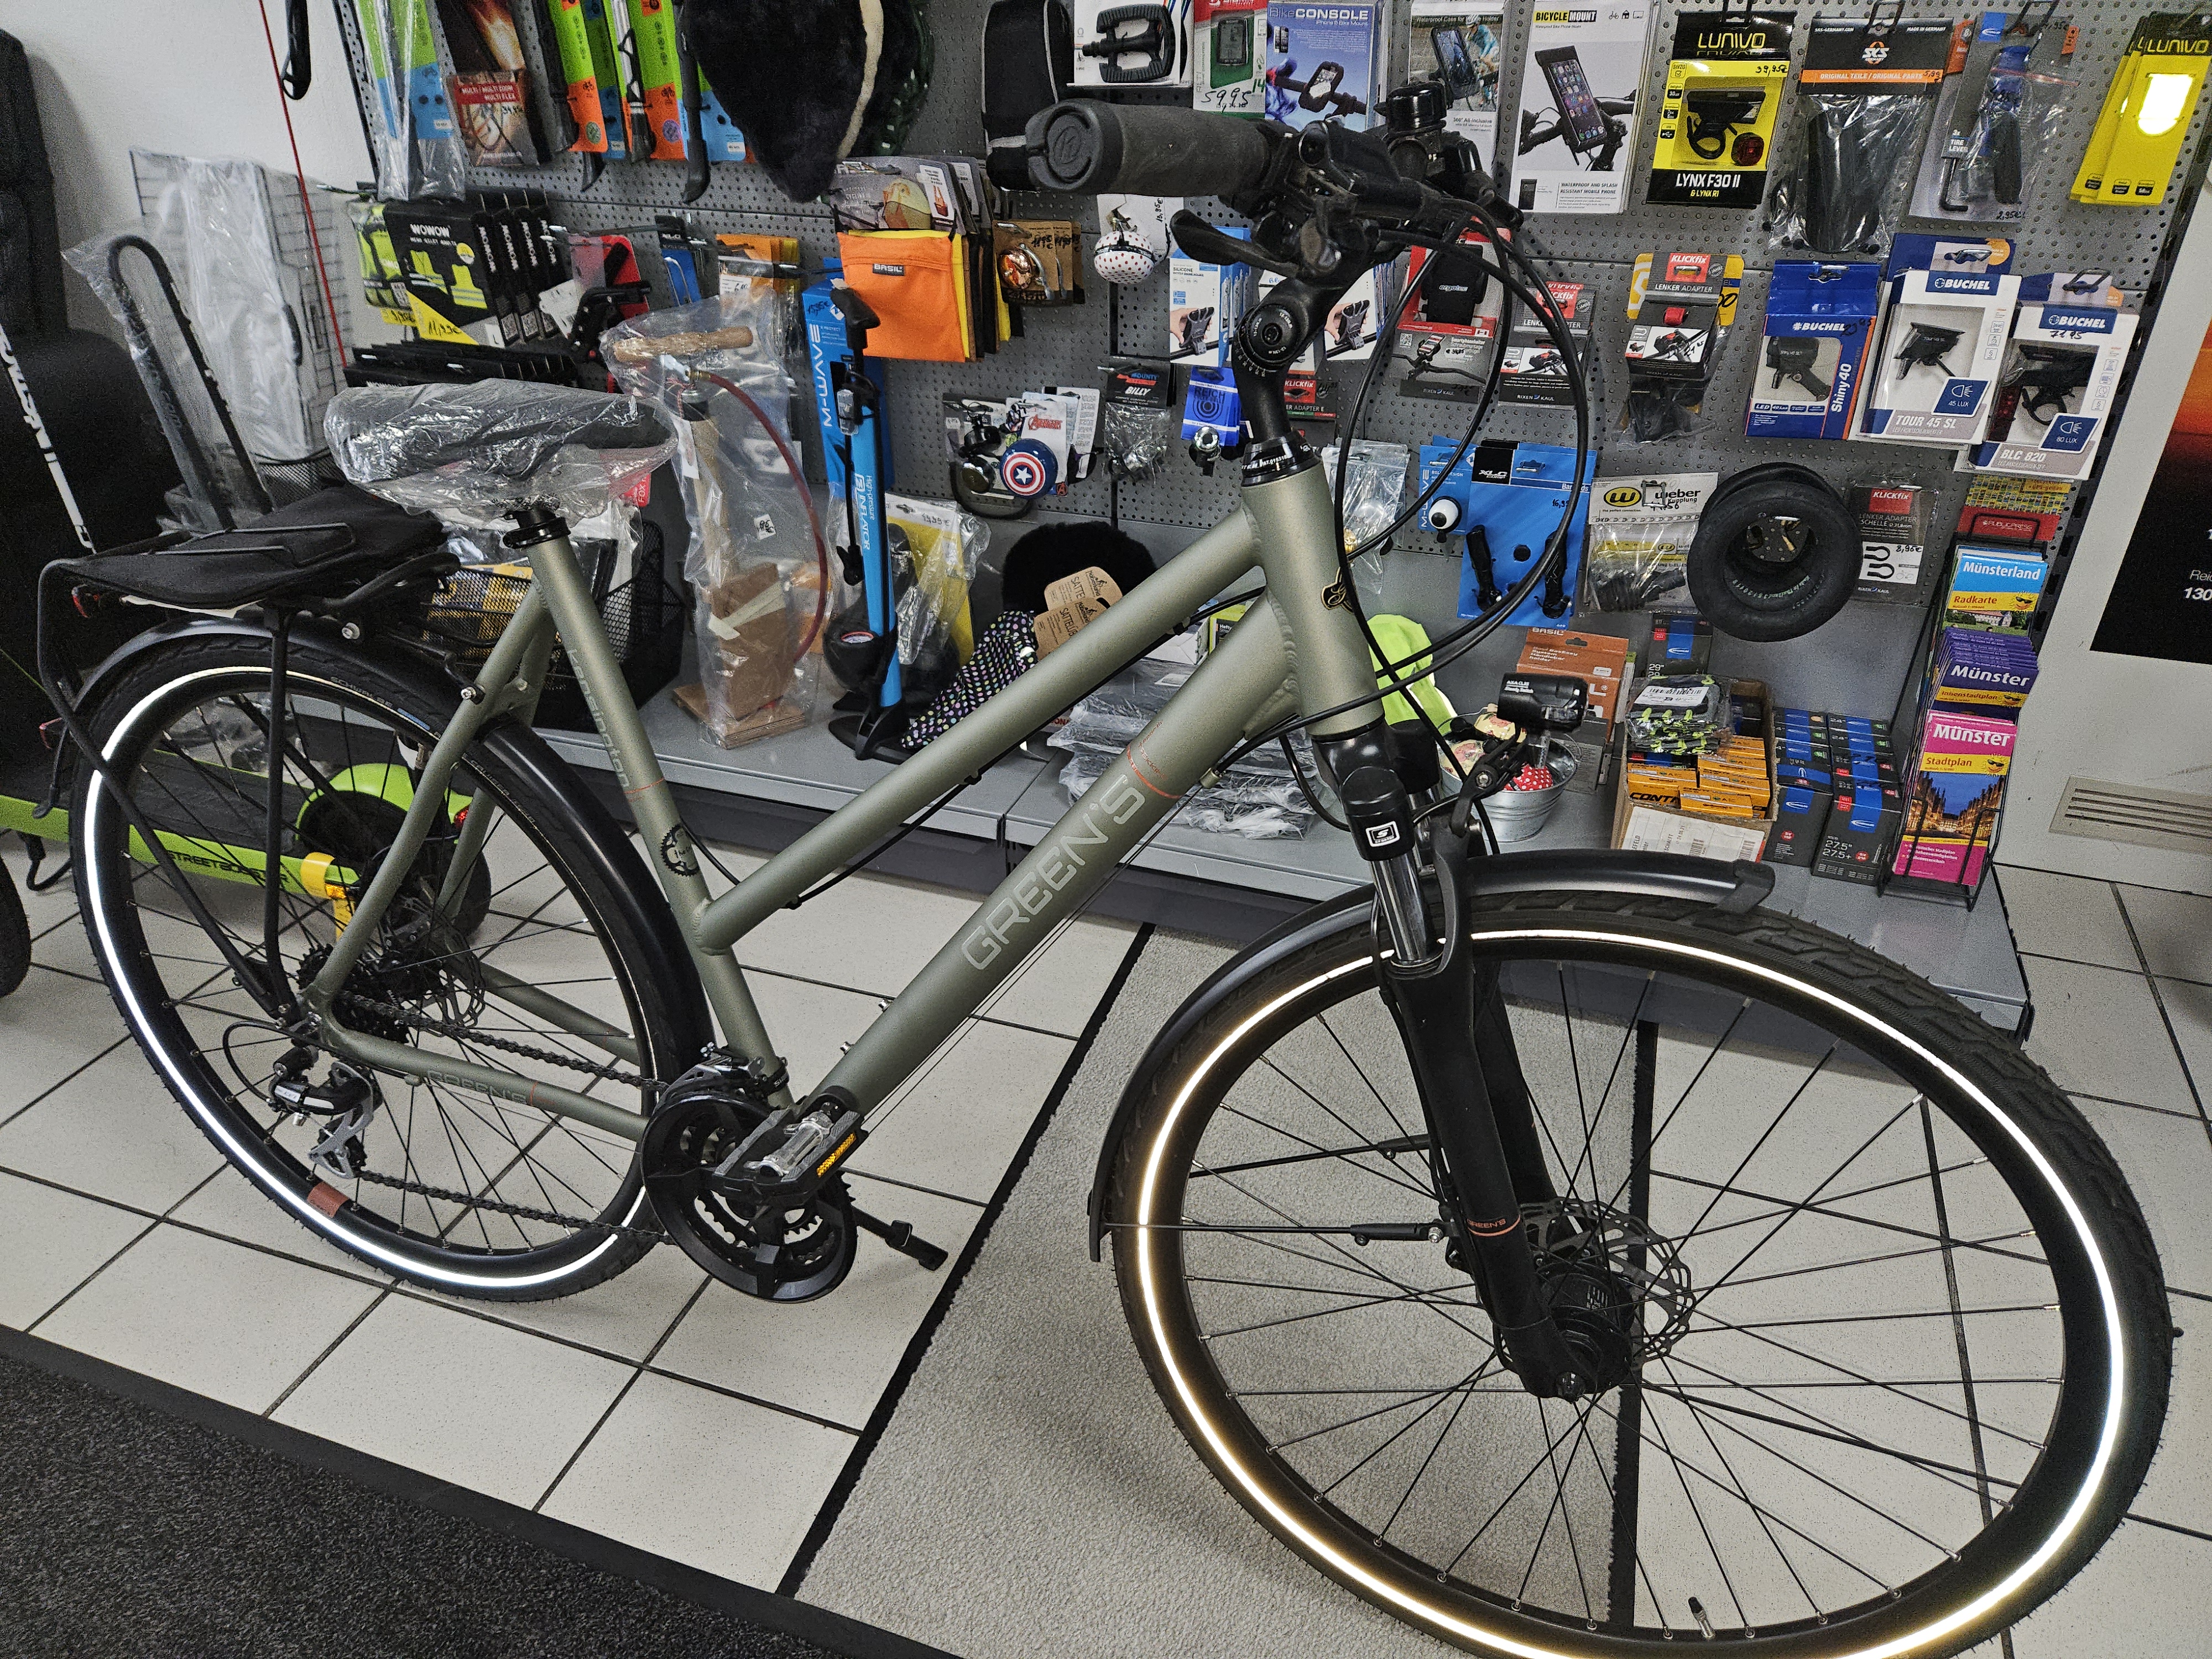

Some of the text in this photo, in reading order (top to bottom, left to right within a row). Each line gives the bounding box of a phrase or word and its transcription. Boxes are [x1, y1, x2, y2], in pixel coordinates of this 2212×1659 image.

[1269, 7, 1369, 20] Bike CONSOLE
[1535, 10, 1597, 22] BICYCLE MOUNT
[1698, 33, 1766, 49] LUNIVO
[2147, 39, 2209, 54] LUNIVO
[1862, 47, 1890, 59] SKS
[1676, 174, 1705, 187] LYNX
[1707, 174, 1732, 187] F30
[410, 223, 450, 239] WOWOW
[1671, 254, 1708, 264] KLICKfix
[874, 263, 903, 273] BASIL
[1681, 284, 1713, 293] ADAPTER
[1124, 385, 1151, 396] BILLY
[1831, 363, 1853, 413] Shiny 40
[1896, 415, 1957, 429] TOUR 45 SL
[2000, 450, 2047, 463] BLC 820
[1655, 489, 1701, 499] weber
[1873, 491, 1910, 500] KLICKfix
[1860, 519, 1888, 527] SCHELLE
[1963, 560, 2041, 581] Münsterland
[1953, 595, 1997, 604] Radkarte
[1532, 627, 1564, 636] BASIL
[1951, 664, 2030, 687] Münster
[1933, 724, 2011, 747] Münster
[1926, 757, 1973, 767] Stadtplan
[961, 774, 1146, 970] GREEN'S
